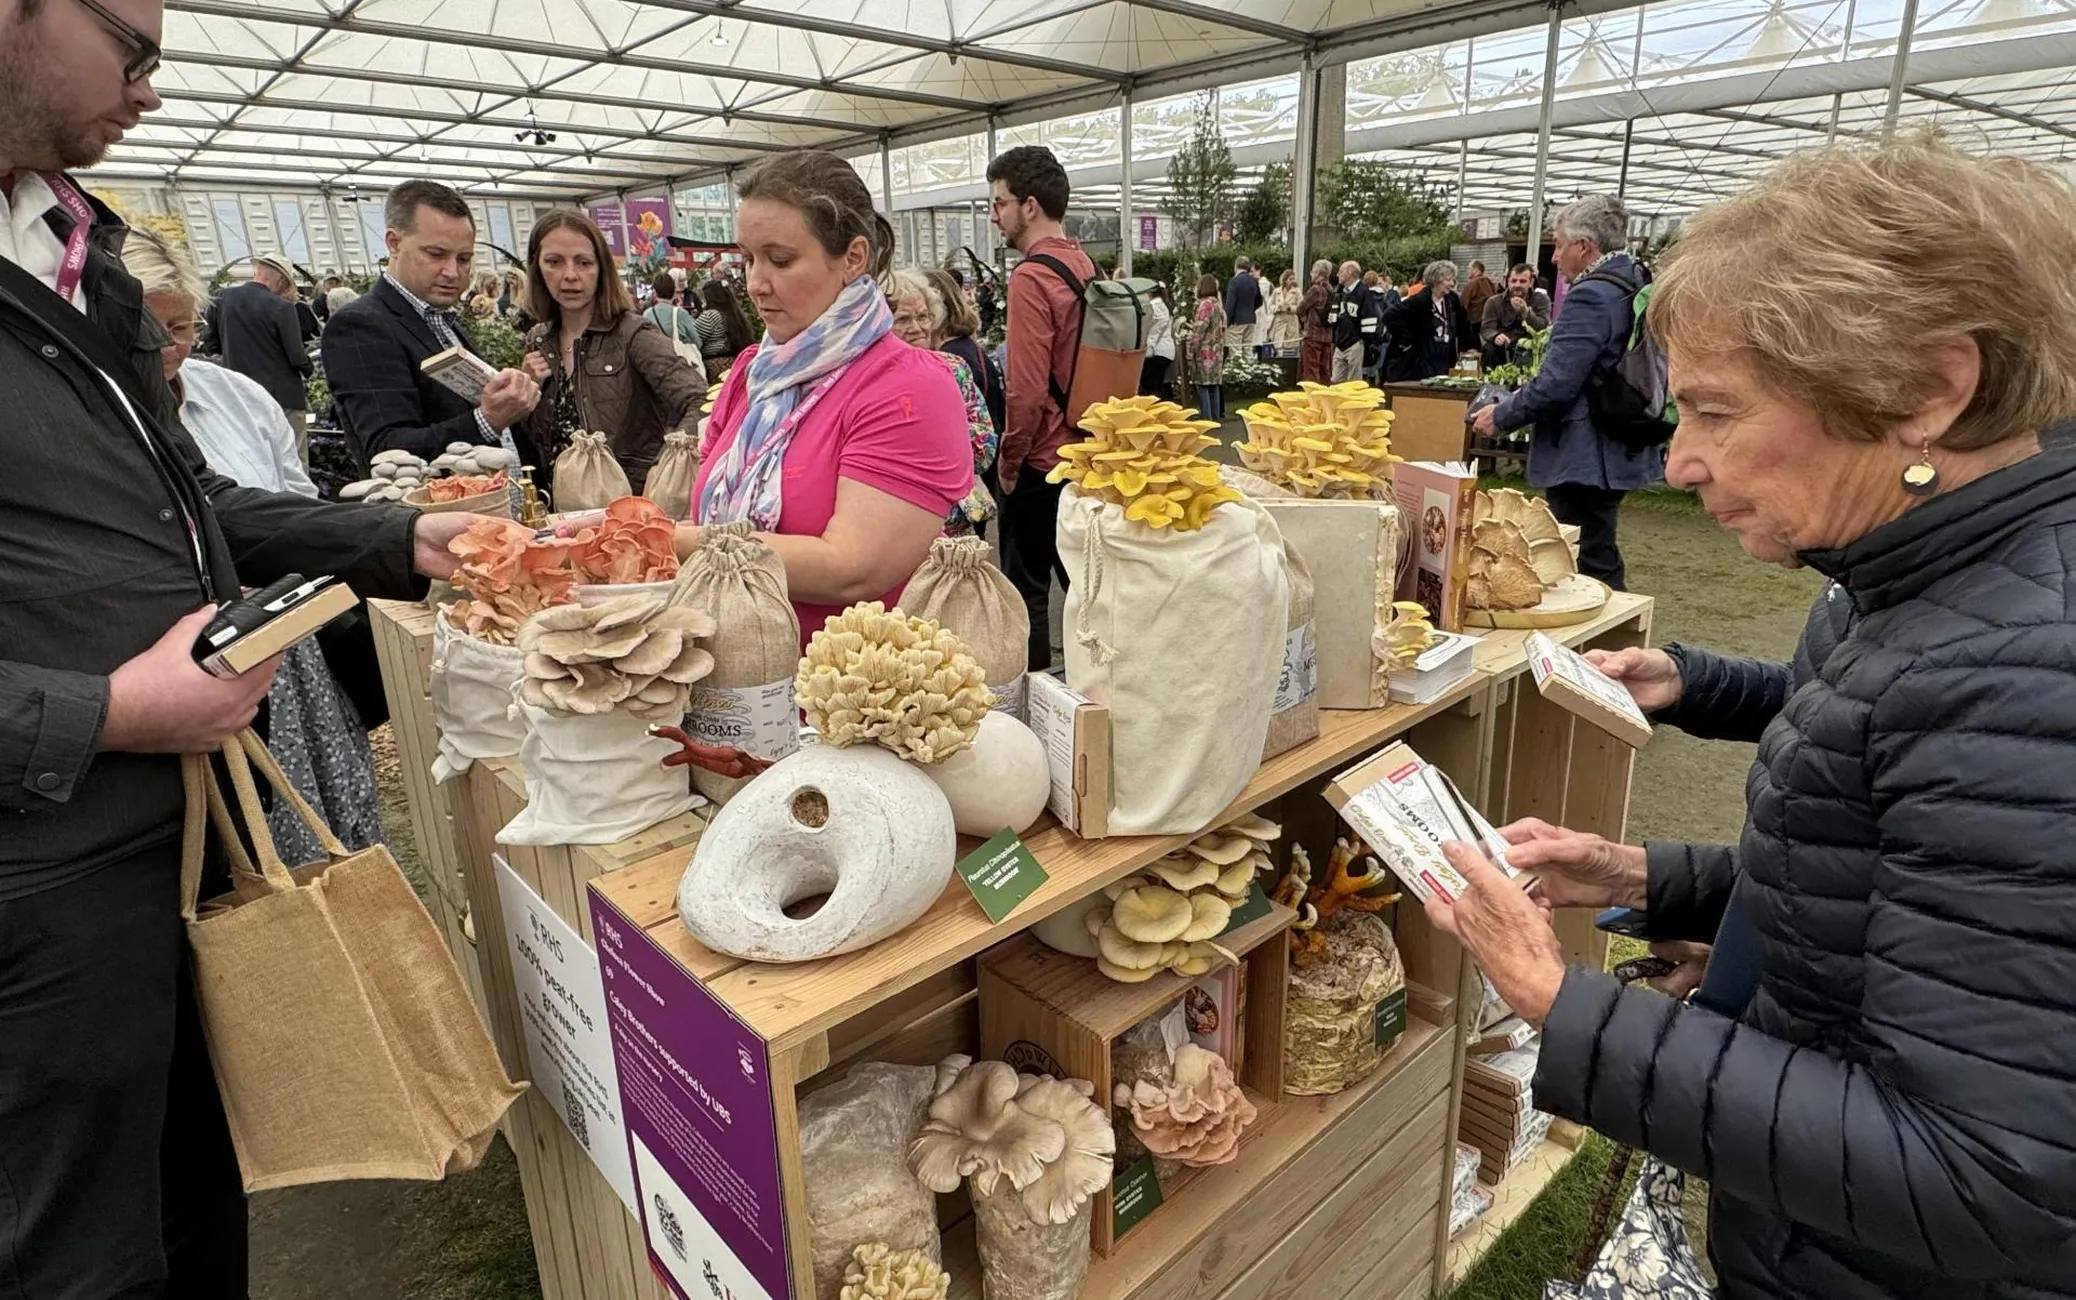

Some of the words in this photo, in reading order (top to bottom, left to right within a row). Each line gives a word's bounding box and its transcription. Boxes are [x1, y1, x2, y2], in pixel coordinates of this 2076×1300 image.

[67, 196, 89, 219] SHO
[1000, 856, 1019, 873] OYSTER
[540, 923, 564, 964] RHS
[605, 920, 624, 949] RHS
[515, 934, 543, 976] 100%
[544, 969, 594, 1033] peat-free
[624, 959, 646, 989] Flower
[646, 982, 666, 1006] Show
[542, 992, 577, 1040] grower
[628, 1009, 658, 1049] Brothers
[658, 1044, 699, 1092] supported
[699, 1084, 711, 1106] by
[712, 1096, 732, 1125] UBS
